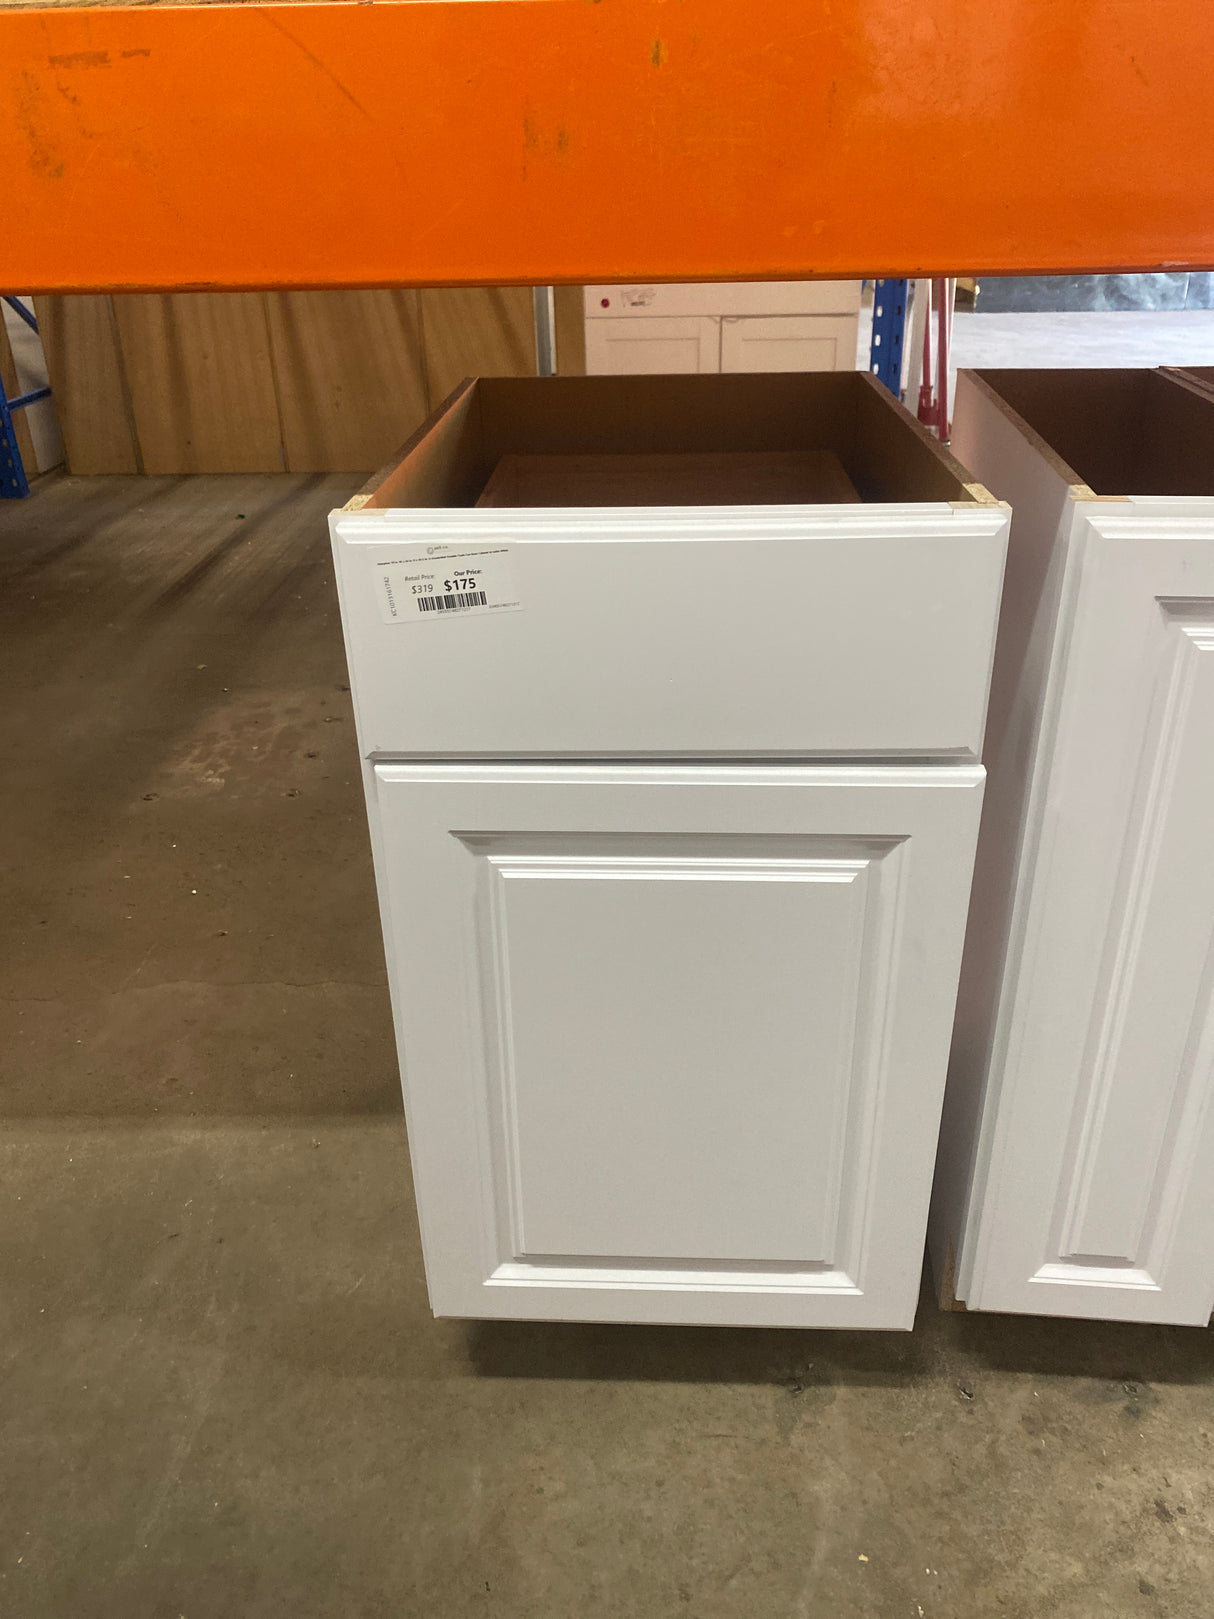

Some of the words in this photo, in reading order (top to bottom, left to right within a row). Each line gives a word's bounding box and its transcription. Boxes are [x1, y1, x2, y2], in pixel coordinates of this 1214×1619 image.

[404, 574, 420, 582] Retail
[411, 584, 433, 594] $319
[444, 578, 476, 592] $175
